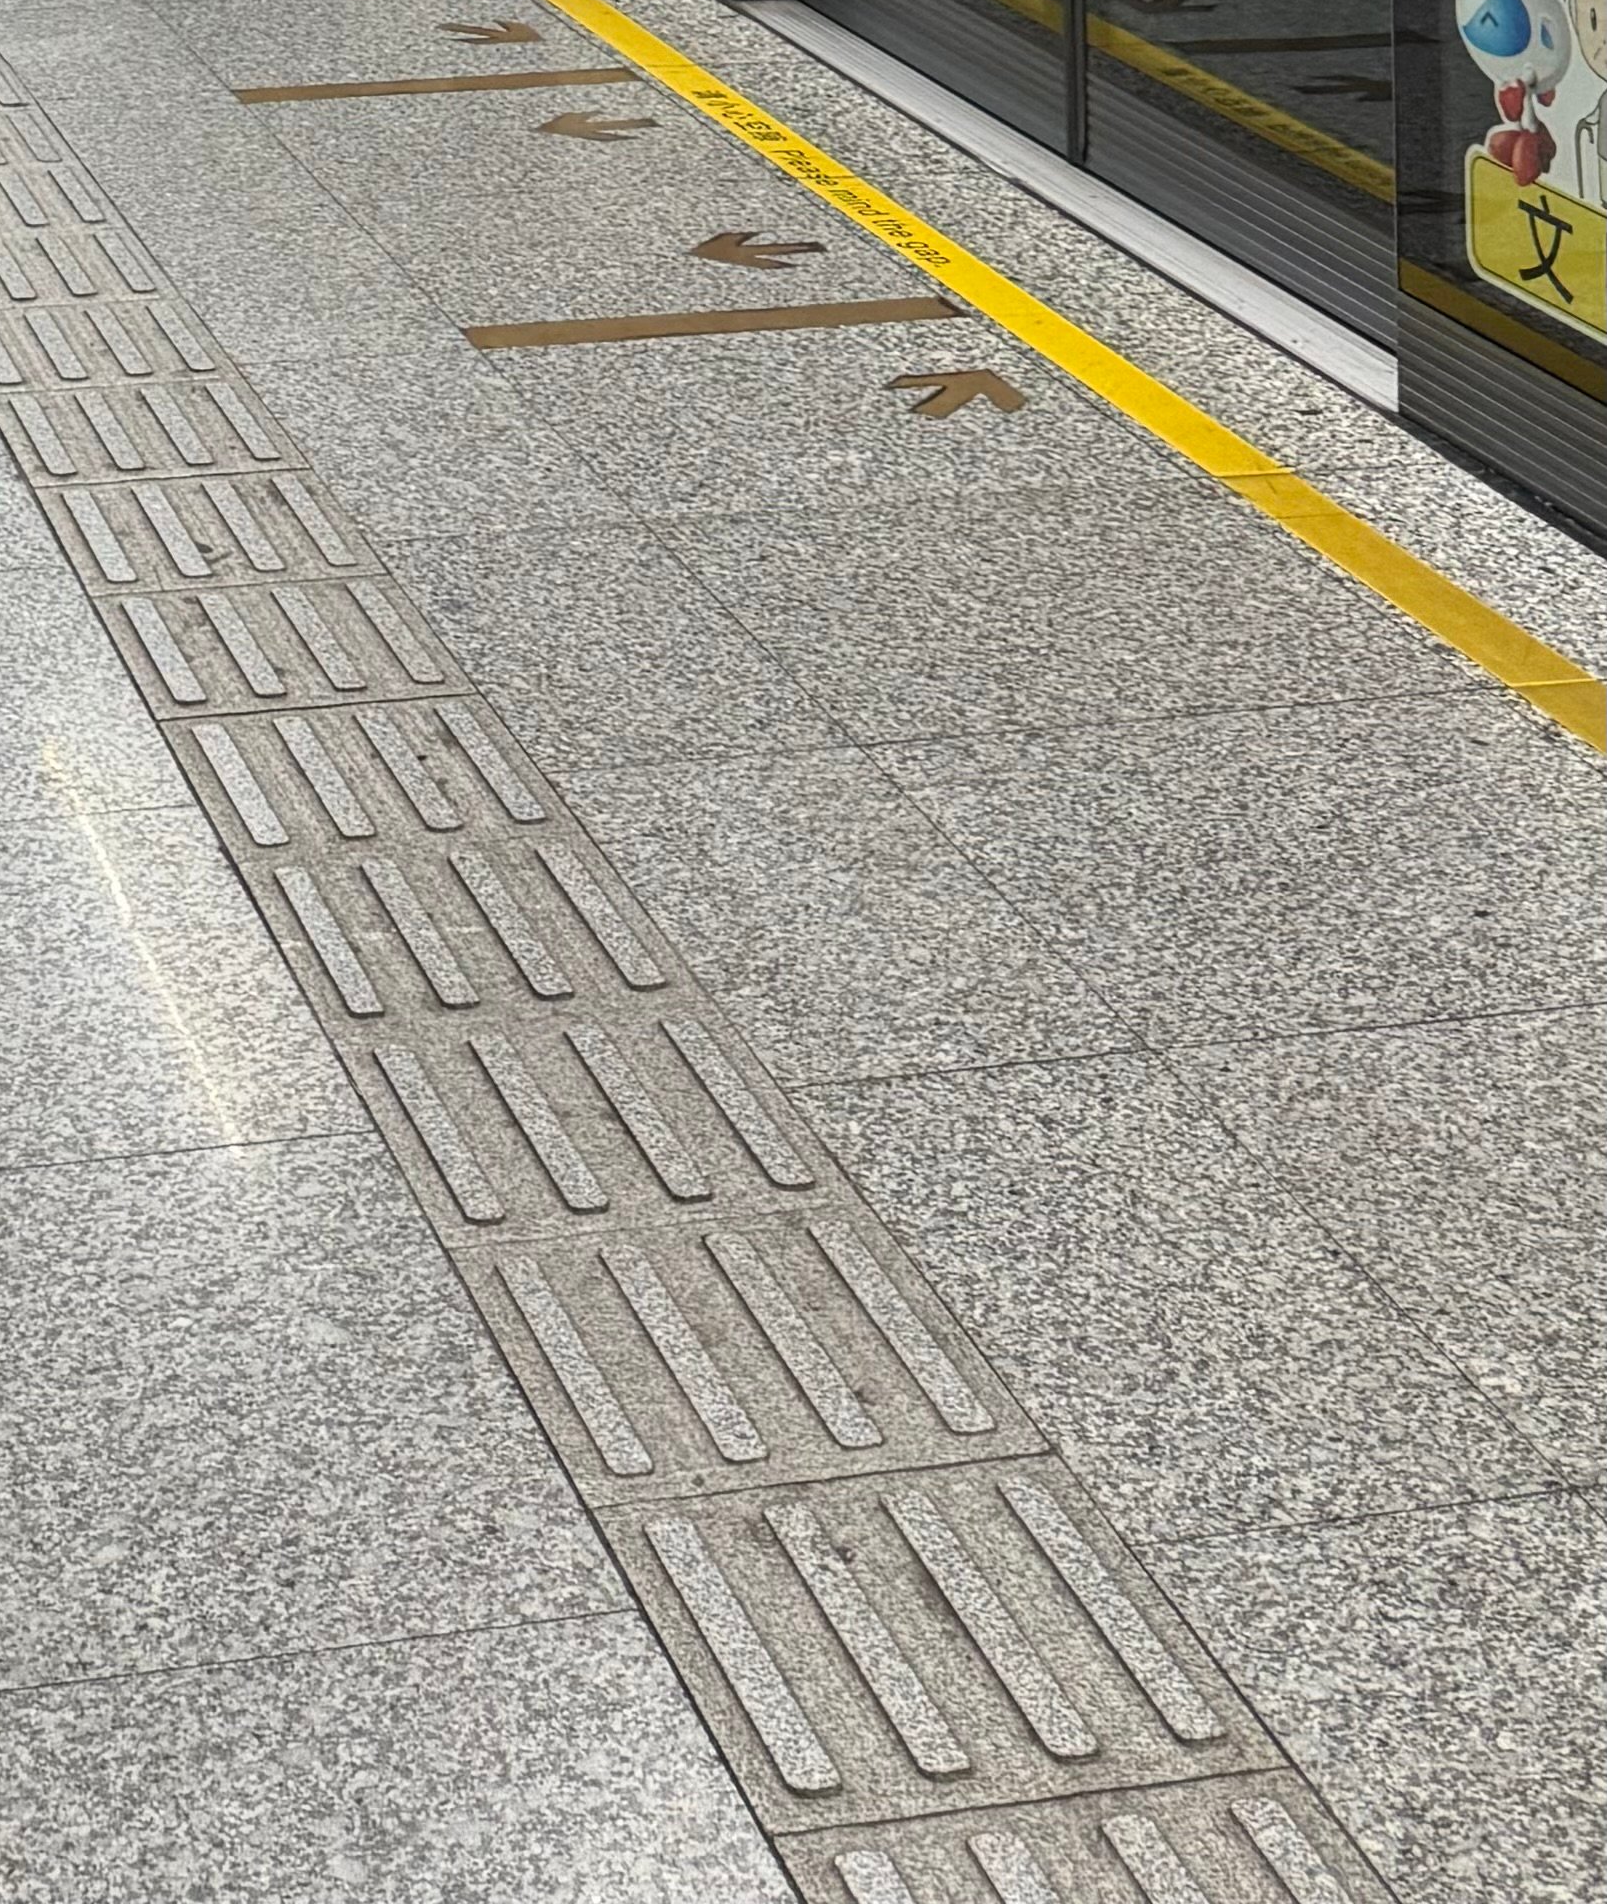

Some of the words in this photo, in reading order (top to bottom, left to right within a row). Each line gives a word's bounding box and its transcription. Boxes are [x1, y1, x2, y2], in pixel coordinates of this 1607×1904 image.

[770, 149, 839, 187] Please
[828, 189, 890, 216] mind
[871, 219, 914, 239] the
[1516, 194, 1574, 305] 文
